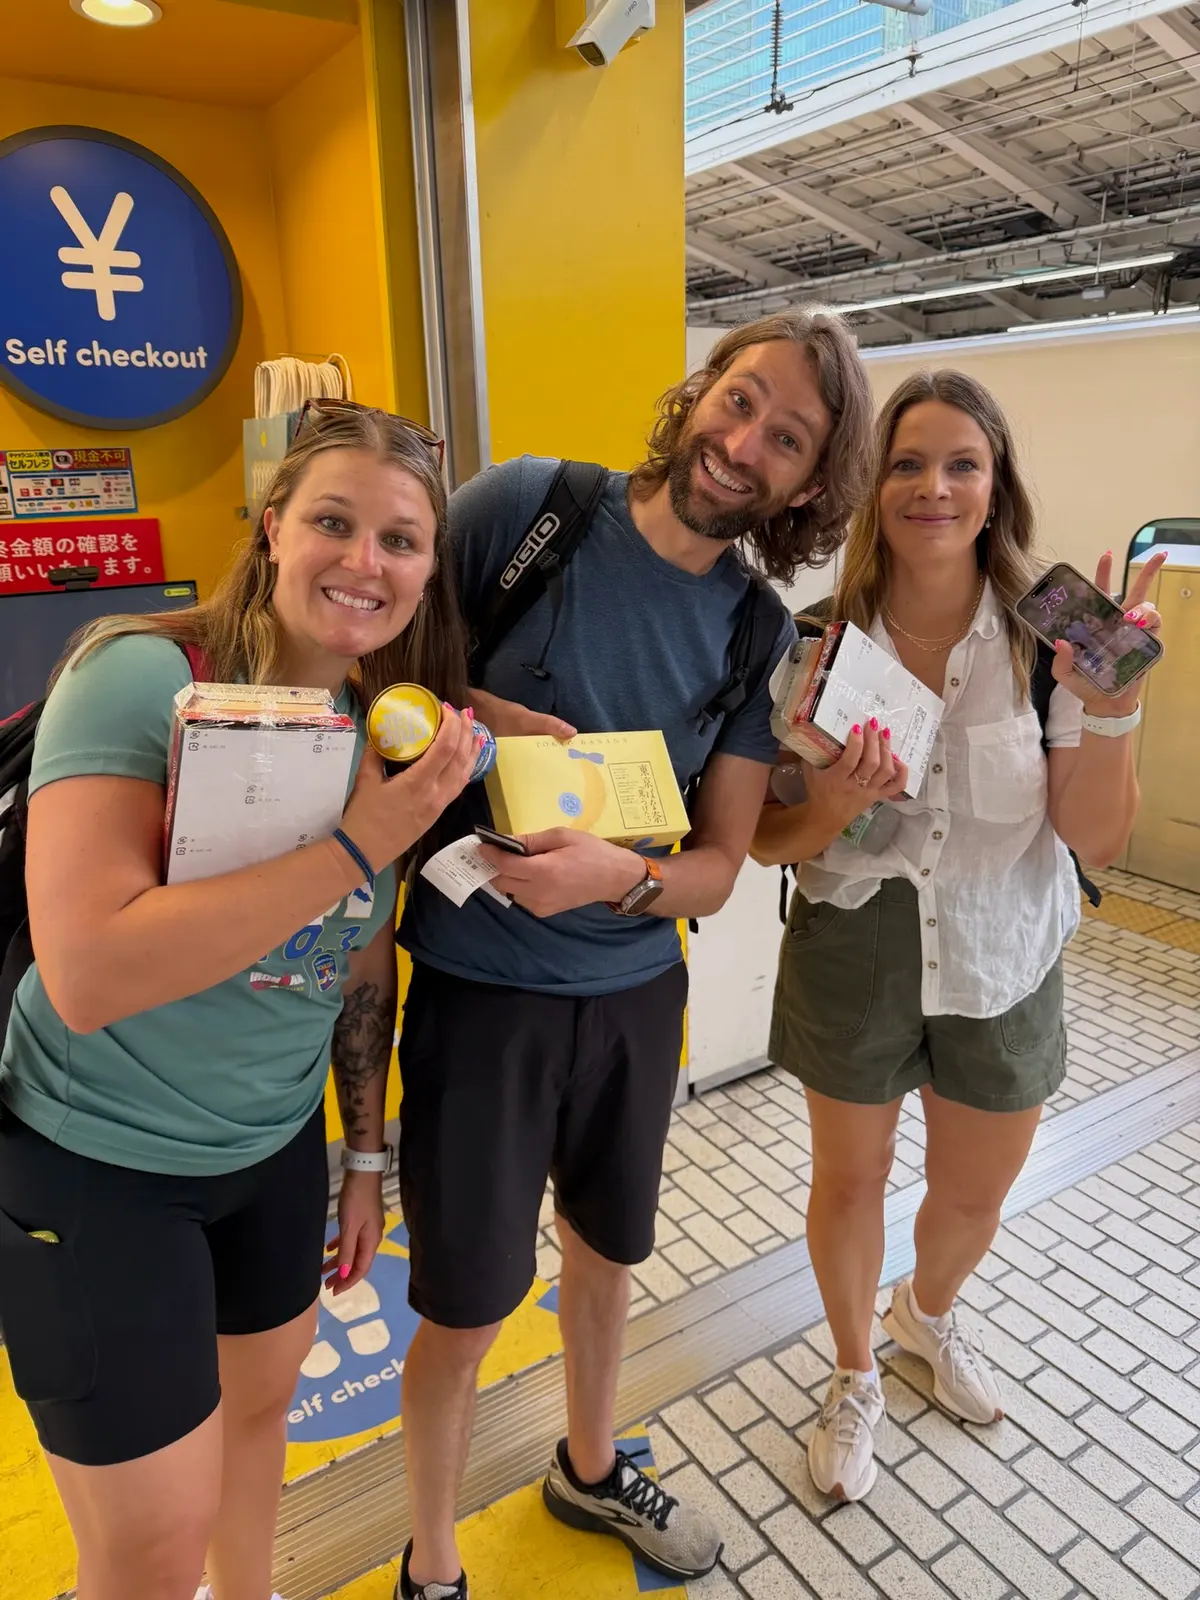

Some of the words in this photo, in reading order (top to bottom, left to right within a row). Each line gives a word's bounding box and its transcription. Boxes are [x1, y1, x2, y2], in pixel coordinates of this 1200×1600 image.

[5, 339, 67, 365] Self
[76, 340, 208, 368] checkout
[9, 459, 50, 470] セルフレジ
[73, 450, 126, 462] 現金不可
[500, 512, 561, 590] OGIO
[1040, 586, 1069, 614] 7:37
[287, 1392, 324, 1424] elf
[331, 1358, 406, 1404] check
